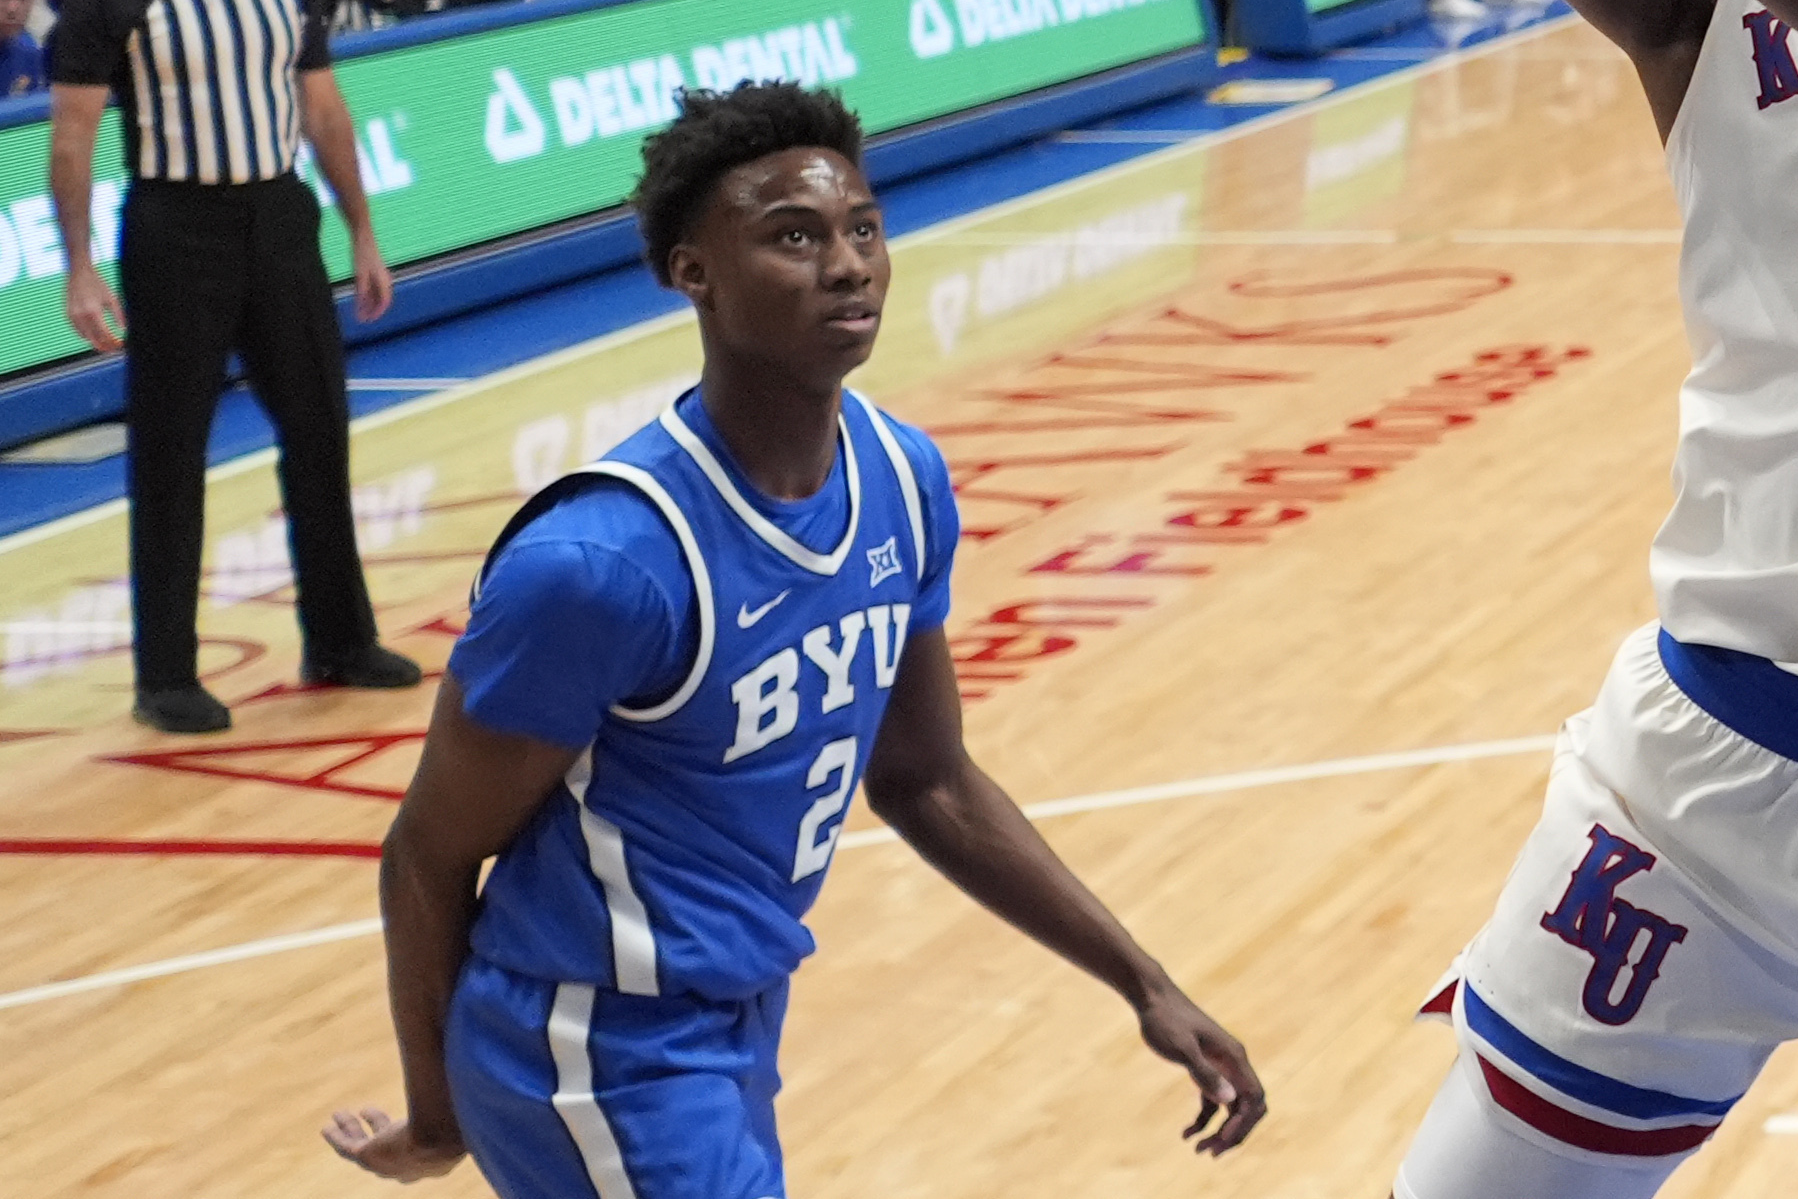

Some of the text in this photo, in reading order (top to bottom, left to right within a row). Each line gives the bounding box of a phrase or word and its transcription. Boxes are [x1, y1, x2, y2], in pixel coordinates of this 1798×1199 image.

[549, 53, 686, 148] DELTA
[722, 602, 912, 765] BYU
[791, 736, 858, 884] 2
[1539, 821, 1689, 1027] KU
